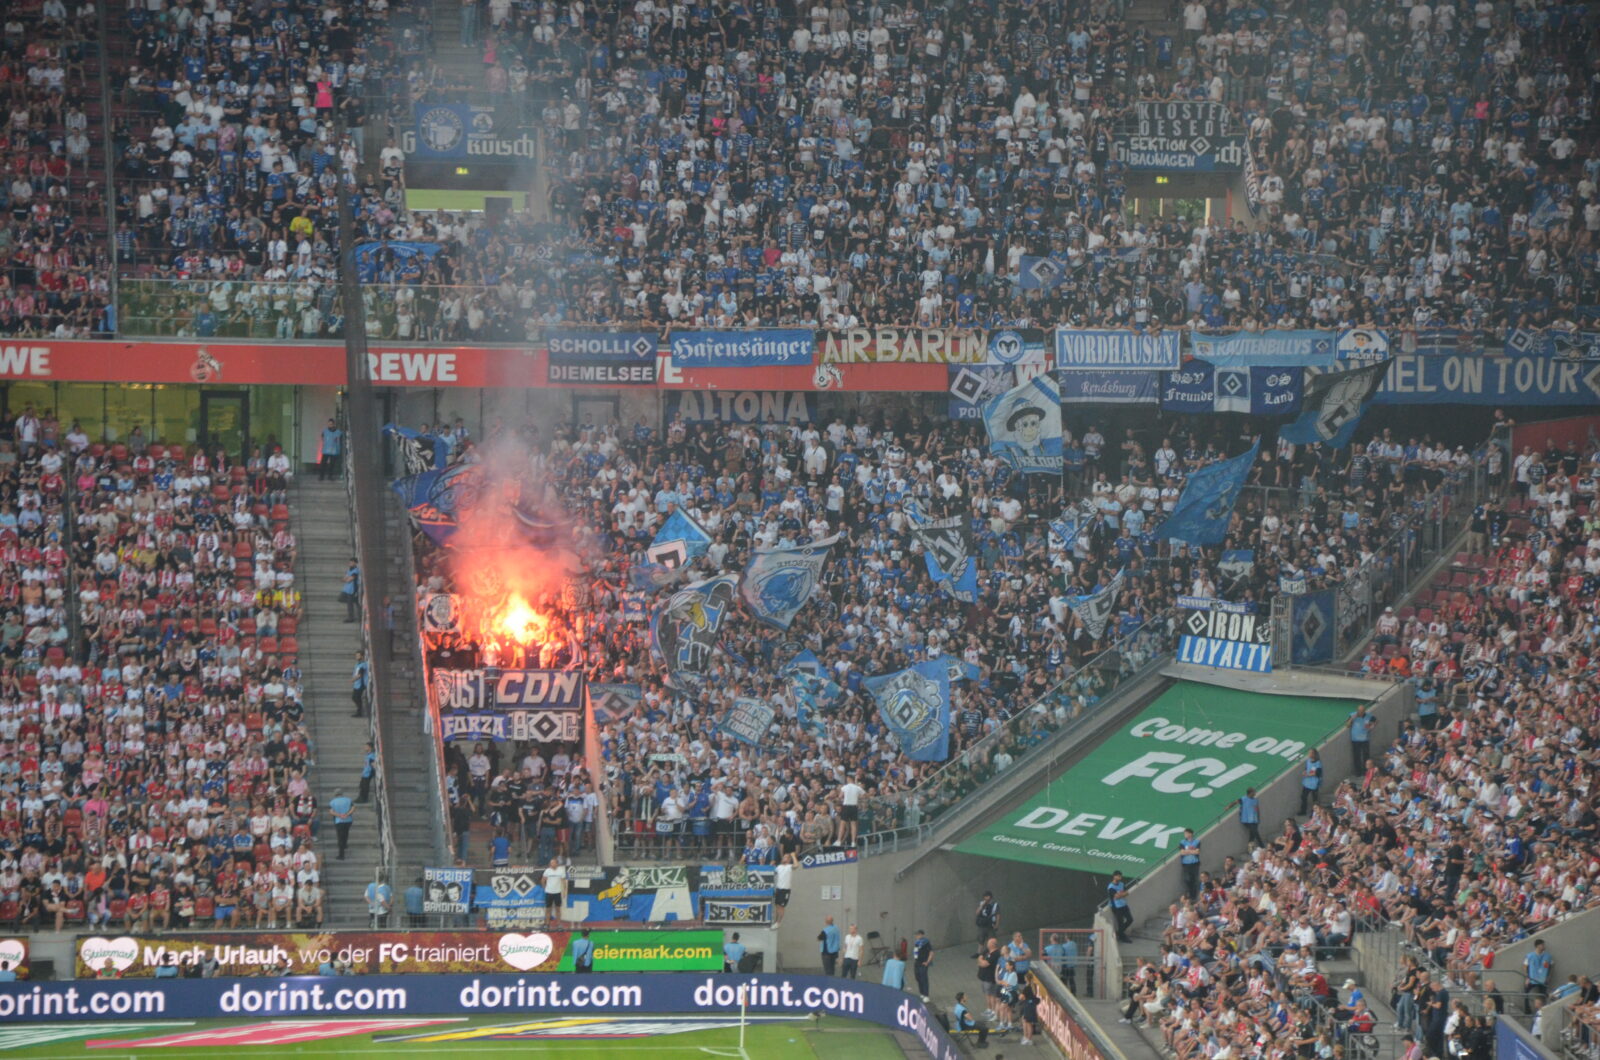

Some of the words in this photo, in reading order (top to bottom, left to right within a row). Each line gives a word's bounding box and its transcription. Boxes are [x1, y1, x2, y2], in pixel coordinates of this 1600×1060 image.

[1140, 103, 1230, 122] KLOSTER
[1140, 119, 1228, 137] OESEDE
[1130, 151, 1196, 168] BAUWAGEN
[550, 337, 630, 354] SCHOLLI
[1063, 334, 1174, 364] NORDHAUSEN
[0, 347, 51, 375] WE
[365, 353, 458, 381] REWE
[550, 364, 654, 381] DIEMELSEE
[1442, 356, 1484, 393] ON
[1493, 356, 1581, 394] TOUR
[1081, 379, 1136, 396] Rendsburg
[1164, 388, 1214, 402] Freunde
[1265, 392, 1294, 405] Land
[677, 390, 810, 422] ALTONA
[1207, 610, 1256, 643] IRON
[1180, 635, 1271, 671] LOYALTY
[497, 671, 580, 704] CDN
[1130, 716, 1247, 750] Come
[1245, 735, 1306, 762] on,
[1101, 751, 1259, 799] FC!
[1013, 806, 1186, 850] DEVK
[815, 851, 847, 865] RNR
[992, 834, 1039, 849] Gesagt.
[1042, 842, 1082, 854] Getan.
[1087, 848, 1147, 864] Geholfen.
[425, 869, 471, 882] BIERIGE
[423, 901, 468, 913] BANDITEN
[143, 945, 206, 966] Mach
[214, 945, 293, 967] Urlaub,
[300, 949, 331, 963] wo
[338, 944, 373, 963] der
[379, 943, 409, 962] FC
[414, 942, 494, 962] trainiert.
[593, 944, 712, 960] eiermark.com
[0, 986, 166, 1016] orint.com
[219, 982, 407, 1012] dorint.com
[460, 978, 642, 1008] dorint.com
[693, 978, 865, 1013] dorint.com
